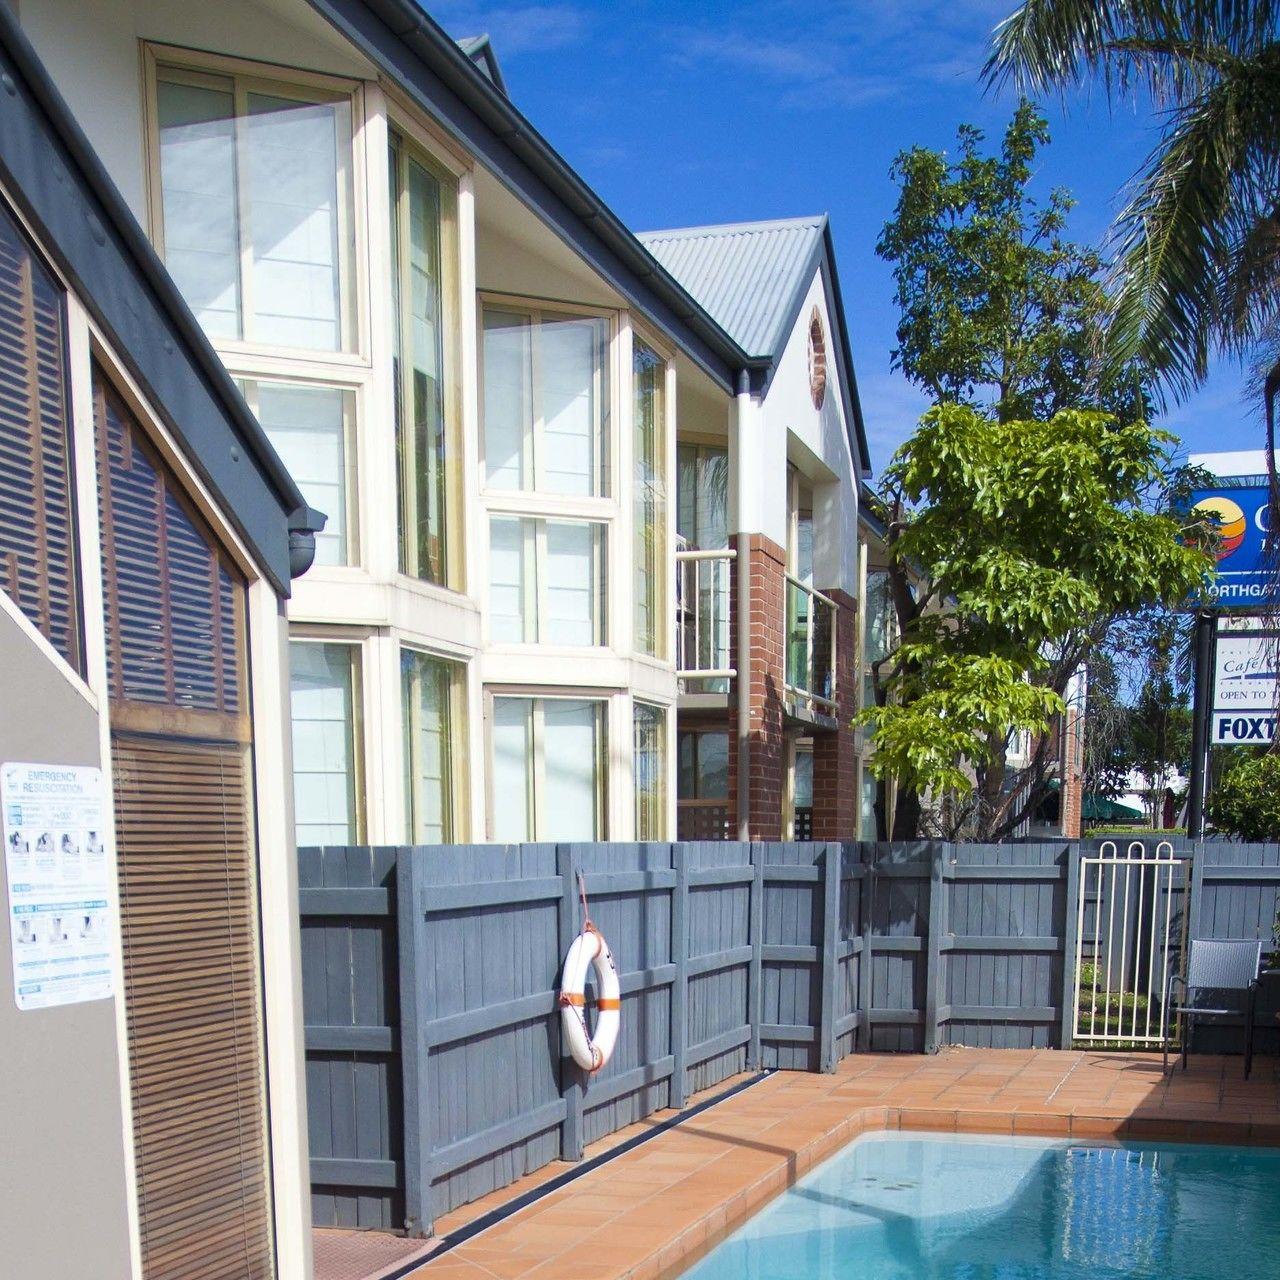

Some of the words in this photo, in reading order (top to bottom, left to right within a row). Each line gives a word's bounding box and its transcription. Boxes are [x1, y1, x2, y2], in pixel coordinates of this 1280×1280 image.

[1220, 690, 1248, 700] OPEN
[1251, 690, 1267, 700] TO
[1218, 717, 1278, 740] FOXT
[27, 771, 78, 782] EMERGENCY
[22, 782, 84, 793] RESUSCITATION
